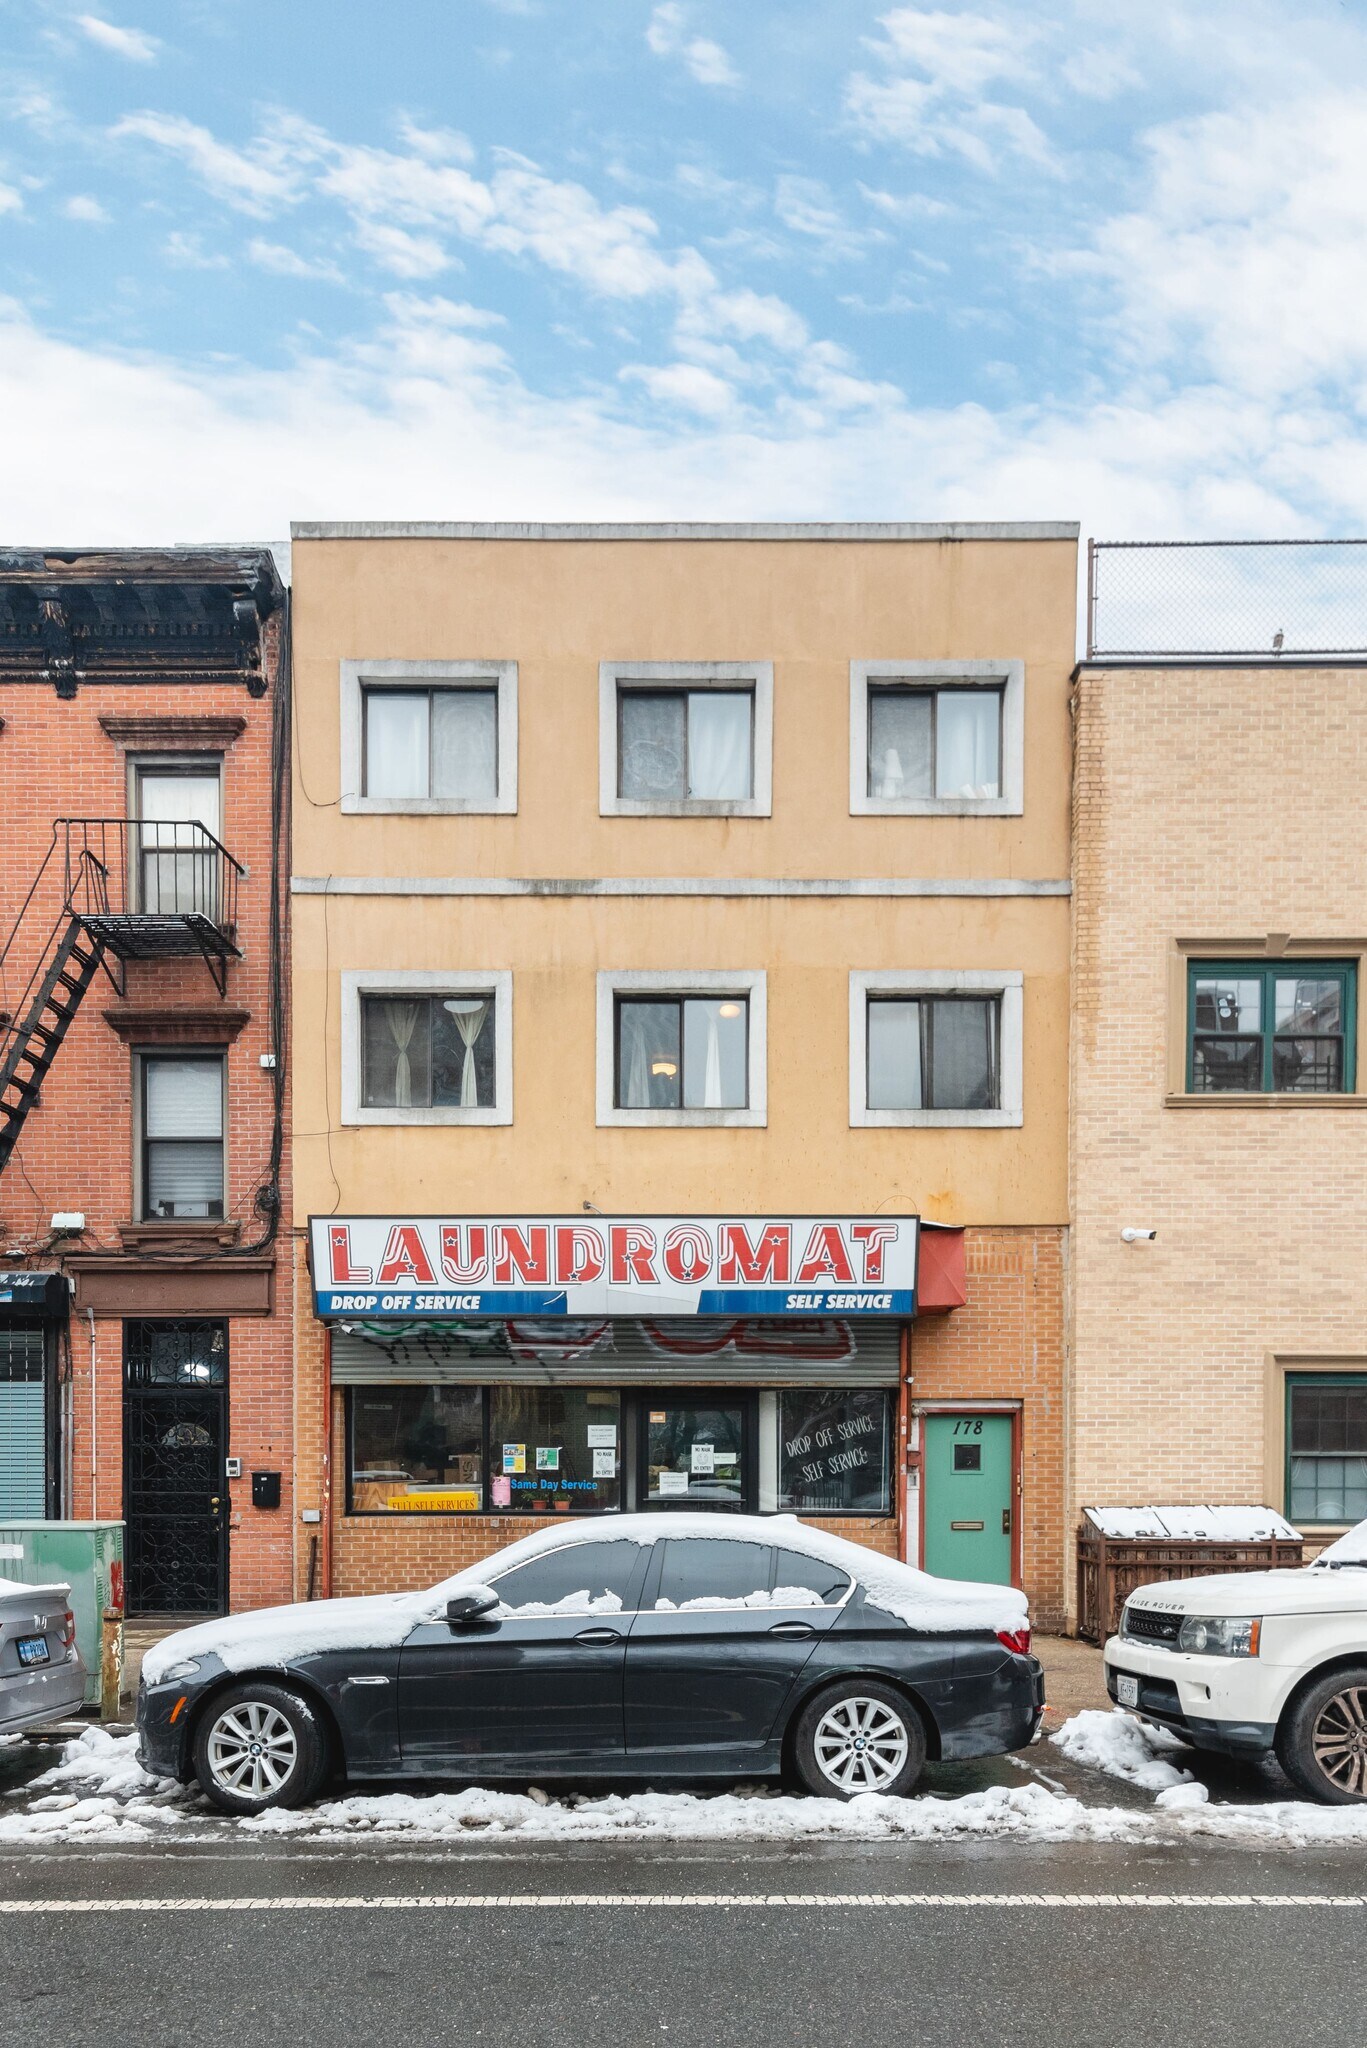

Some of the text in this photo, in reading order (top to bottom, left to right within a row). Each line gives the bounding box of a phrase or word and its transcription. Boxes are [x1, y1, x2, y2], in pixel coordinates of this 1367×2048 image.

[328, 1223, 899, 1285] LAUNDROMAT
[331, 1295, 481, 1310] DROP OFF SERVICE
[786, 1294, 893, 1309] SELF SERVICE
[952, 1420, 983, 1435] 178
[785, 1414, 876, 1457] DROP OFF SERVICE
[802, 1460, 823, 1483] SELF
[511, 1479, 598, 1491] Same Day Service
[1152, 1601, 1185, 1611] ROVER
